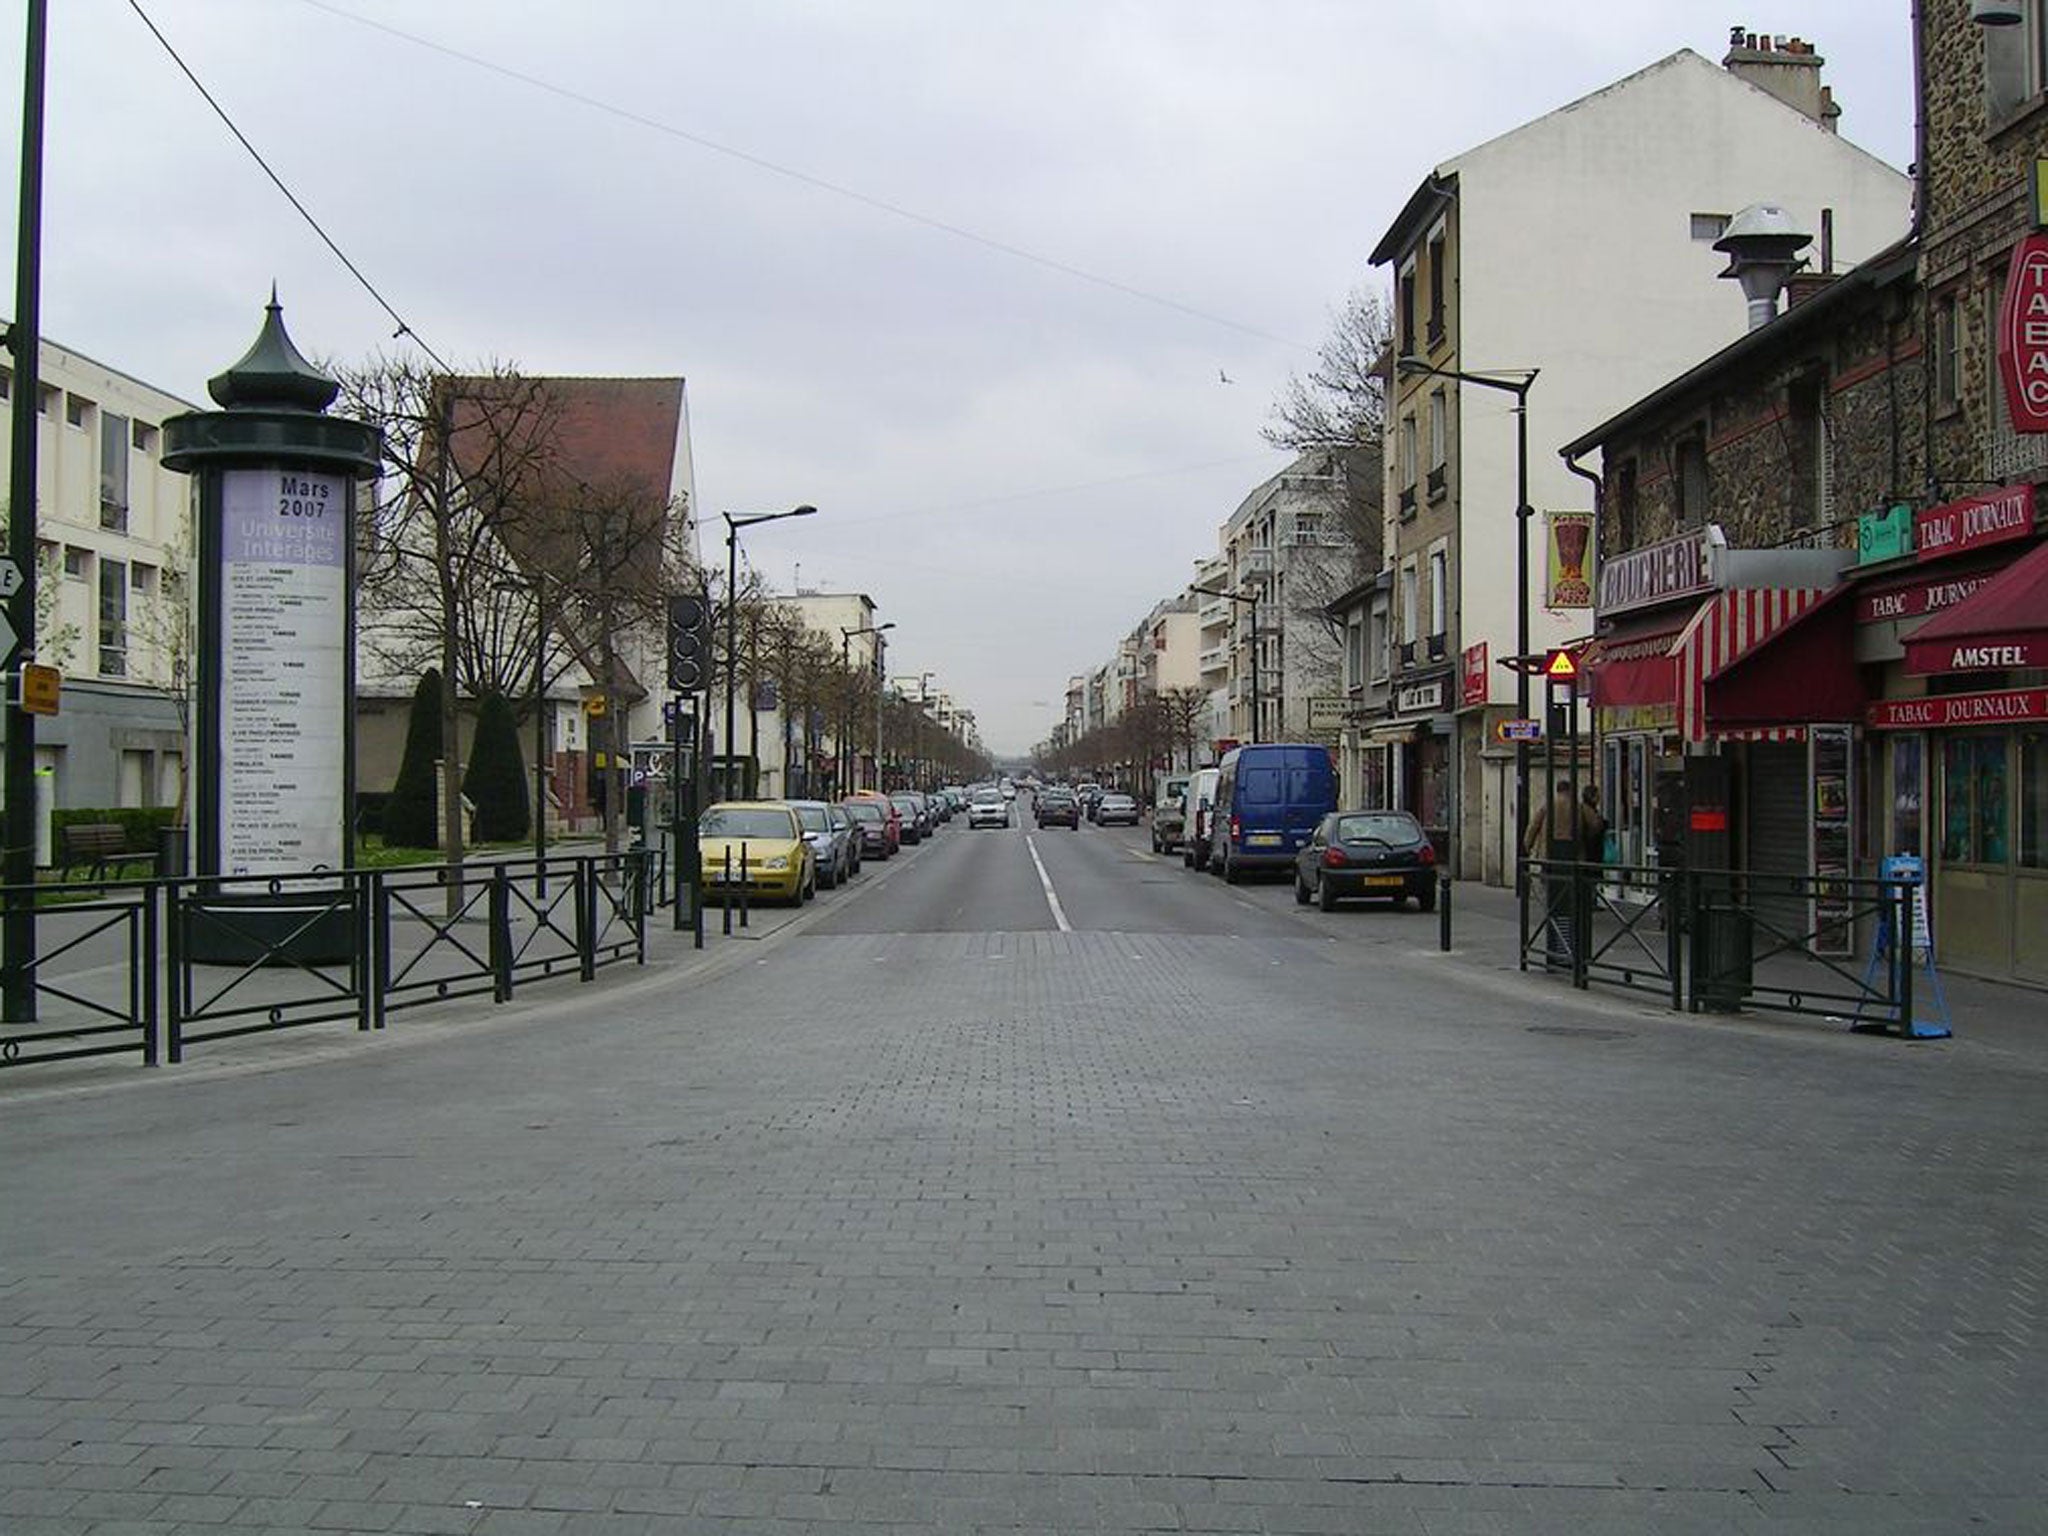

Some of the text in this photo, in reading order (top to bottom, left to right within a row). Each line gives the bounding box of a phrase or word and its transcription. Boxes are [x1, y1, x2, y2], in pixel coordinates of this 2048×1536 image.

[2024, 263, 2048, 404] TABAC
[281, 476, 329, 499] Mars
[279, 499, 326, 518] 2007
[1920, 514, 1956, 550] TABAC
[1960, 493, 2027, 546] JOURNAUX
[1604, 537, 1706, 609] BOUCHERIE
[1871, 592, 1908, 618] TABAC
[1951, 646, 2026, 668] AMSTEL
[1888, 695, 2031, 724] TABAC JOURNAUX
